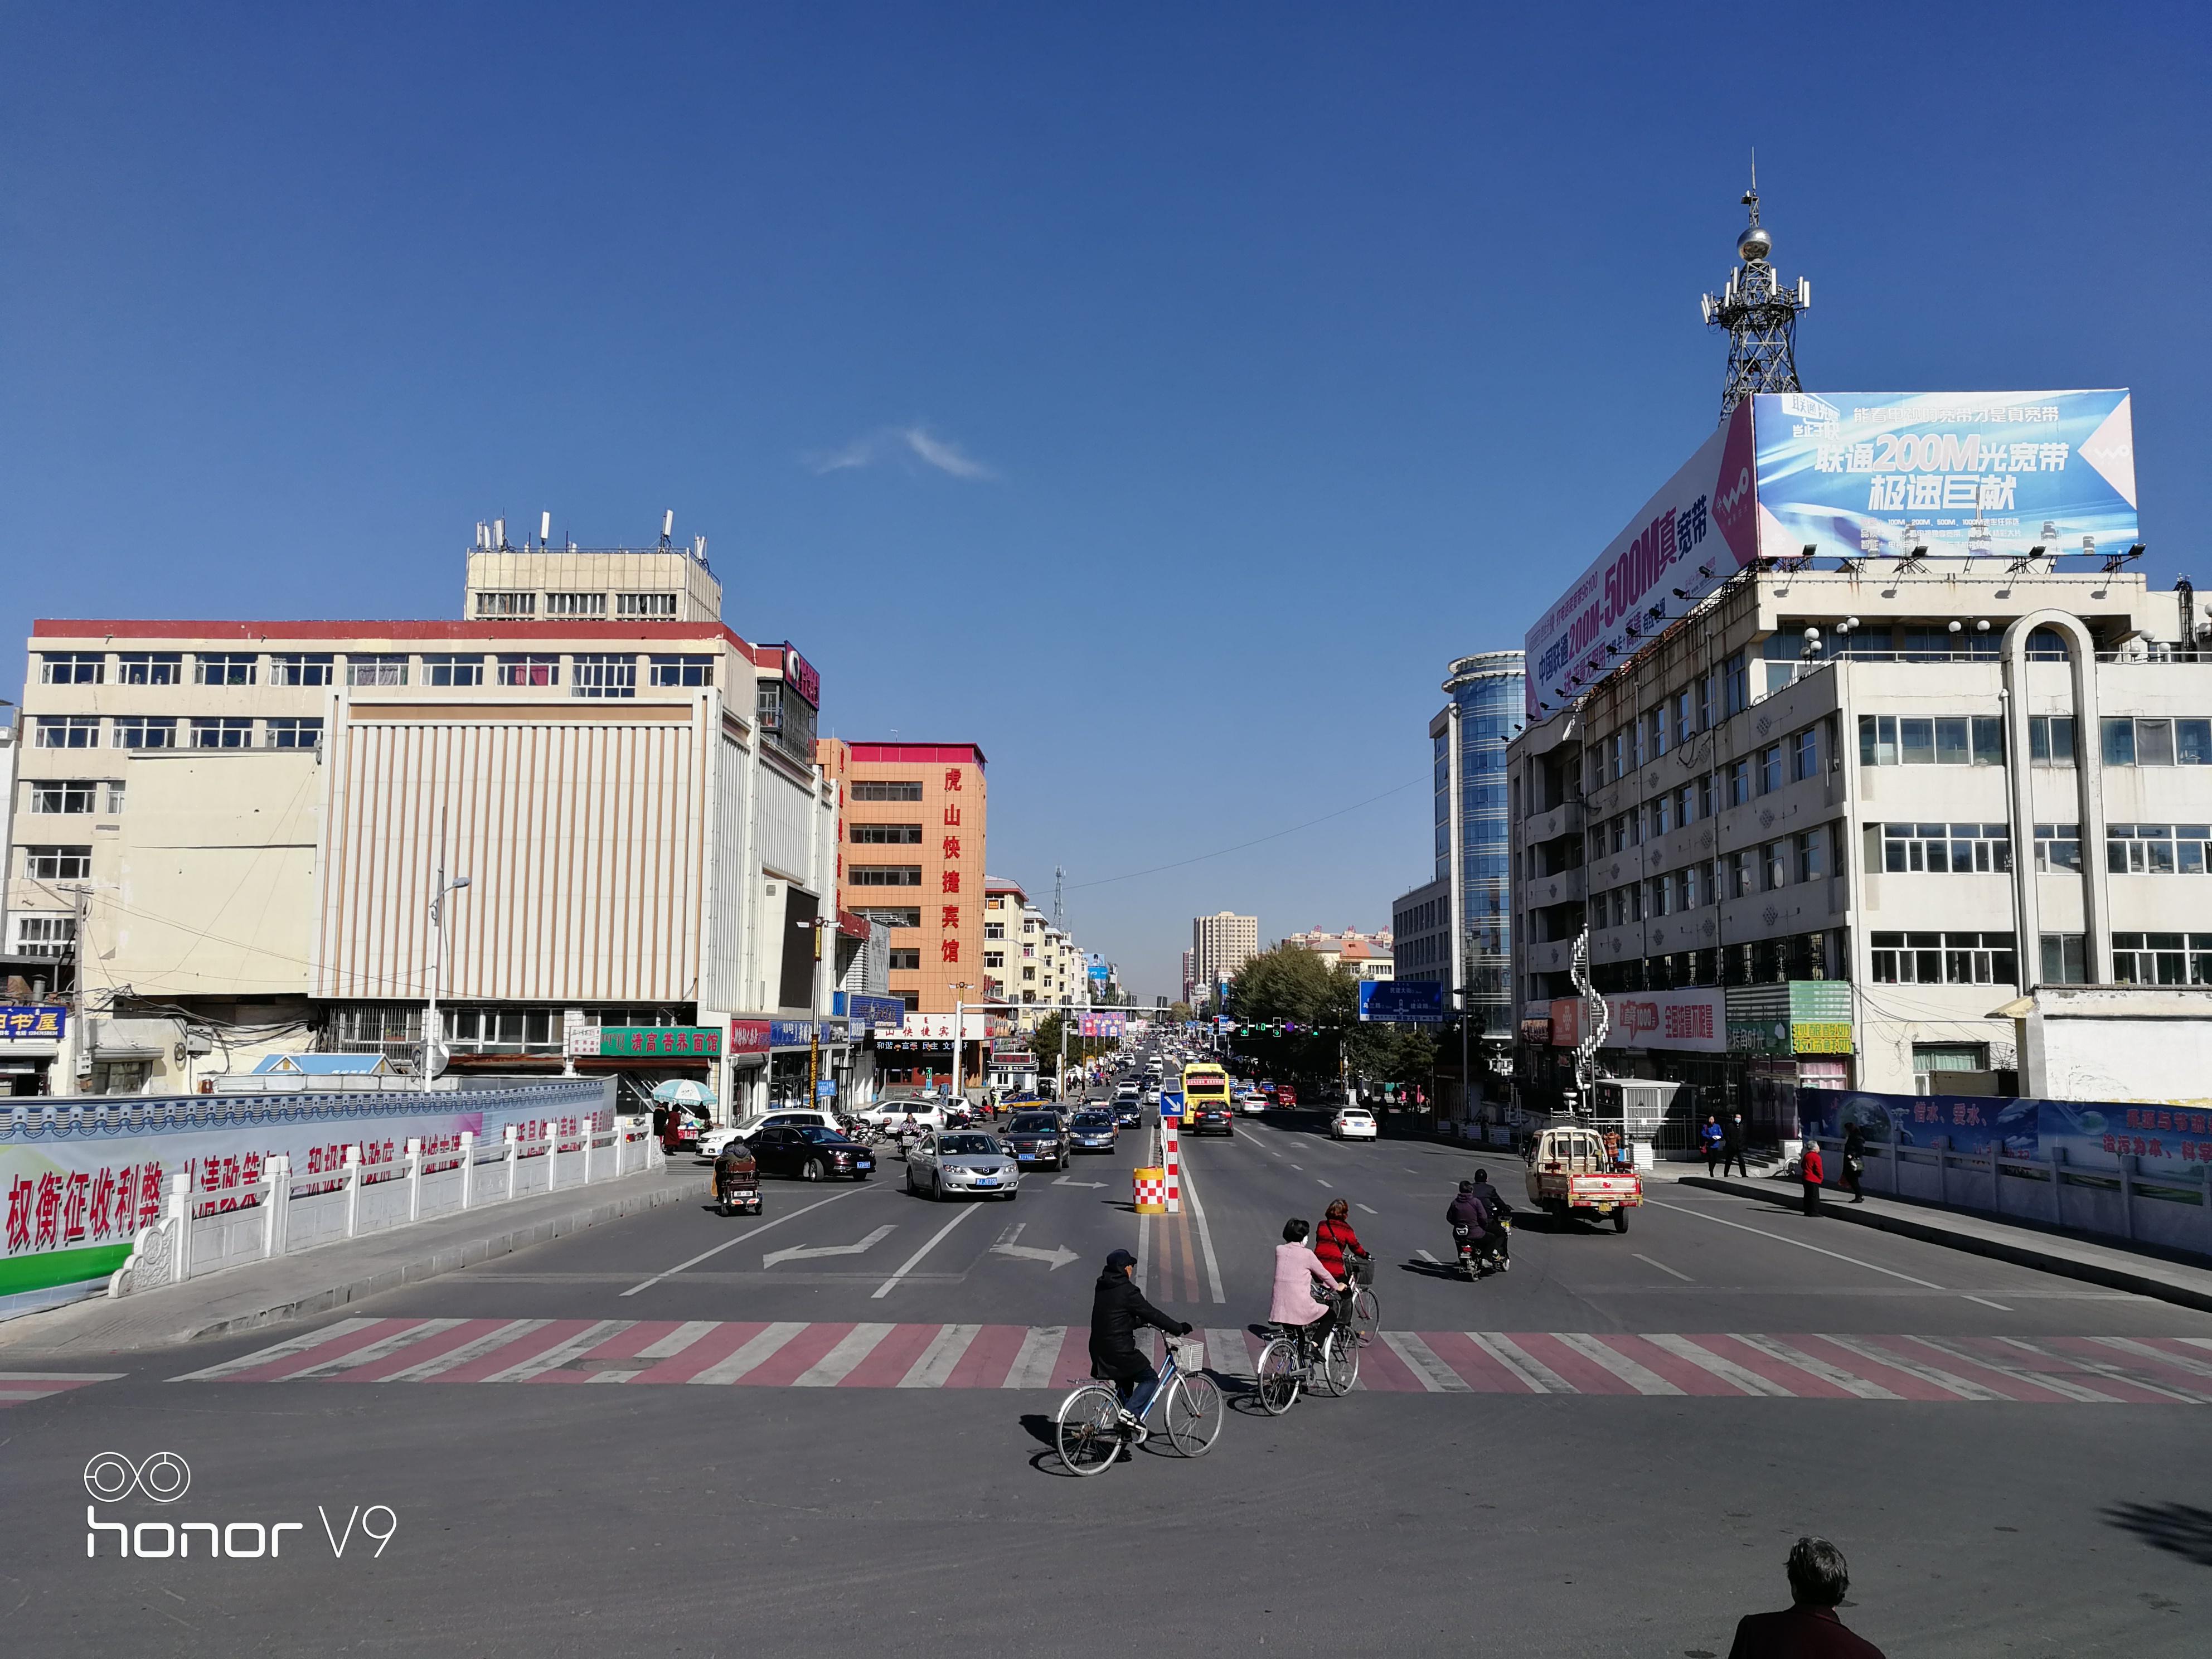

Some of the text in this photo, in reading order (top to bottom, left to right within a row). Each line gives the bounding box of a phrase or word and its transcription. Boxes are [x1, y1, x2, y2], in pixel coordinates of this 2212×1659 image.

[1854, 407, 2059, 423] 能看电视的宽带才是真宽带
[1816, 434, 2069, 473] 联通200M光宽带
[1867, 474, 2017, 511] 极速巨献
[941, 768, 963, 963] 虎山快捷宾馆
[1665, 1005, 1714, 1039] 全国流量不限量
[1793, 1023, 1851, 1038] 现酿酸奶
[1794, 1038, 1852, 1054] 牧场鲜奶
[2127, 1109, 2212, 1136] 开源与节流
[6, 1160, 163, 1250] 权衡征收利弊
